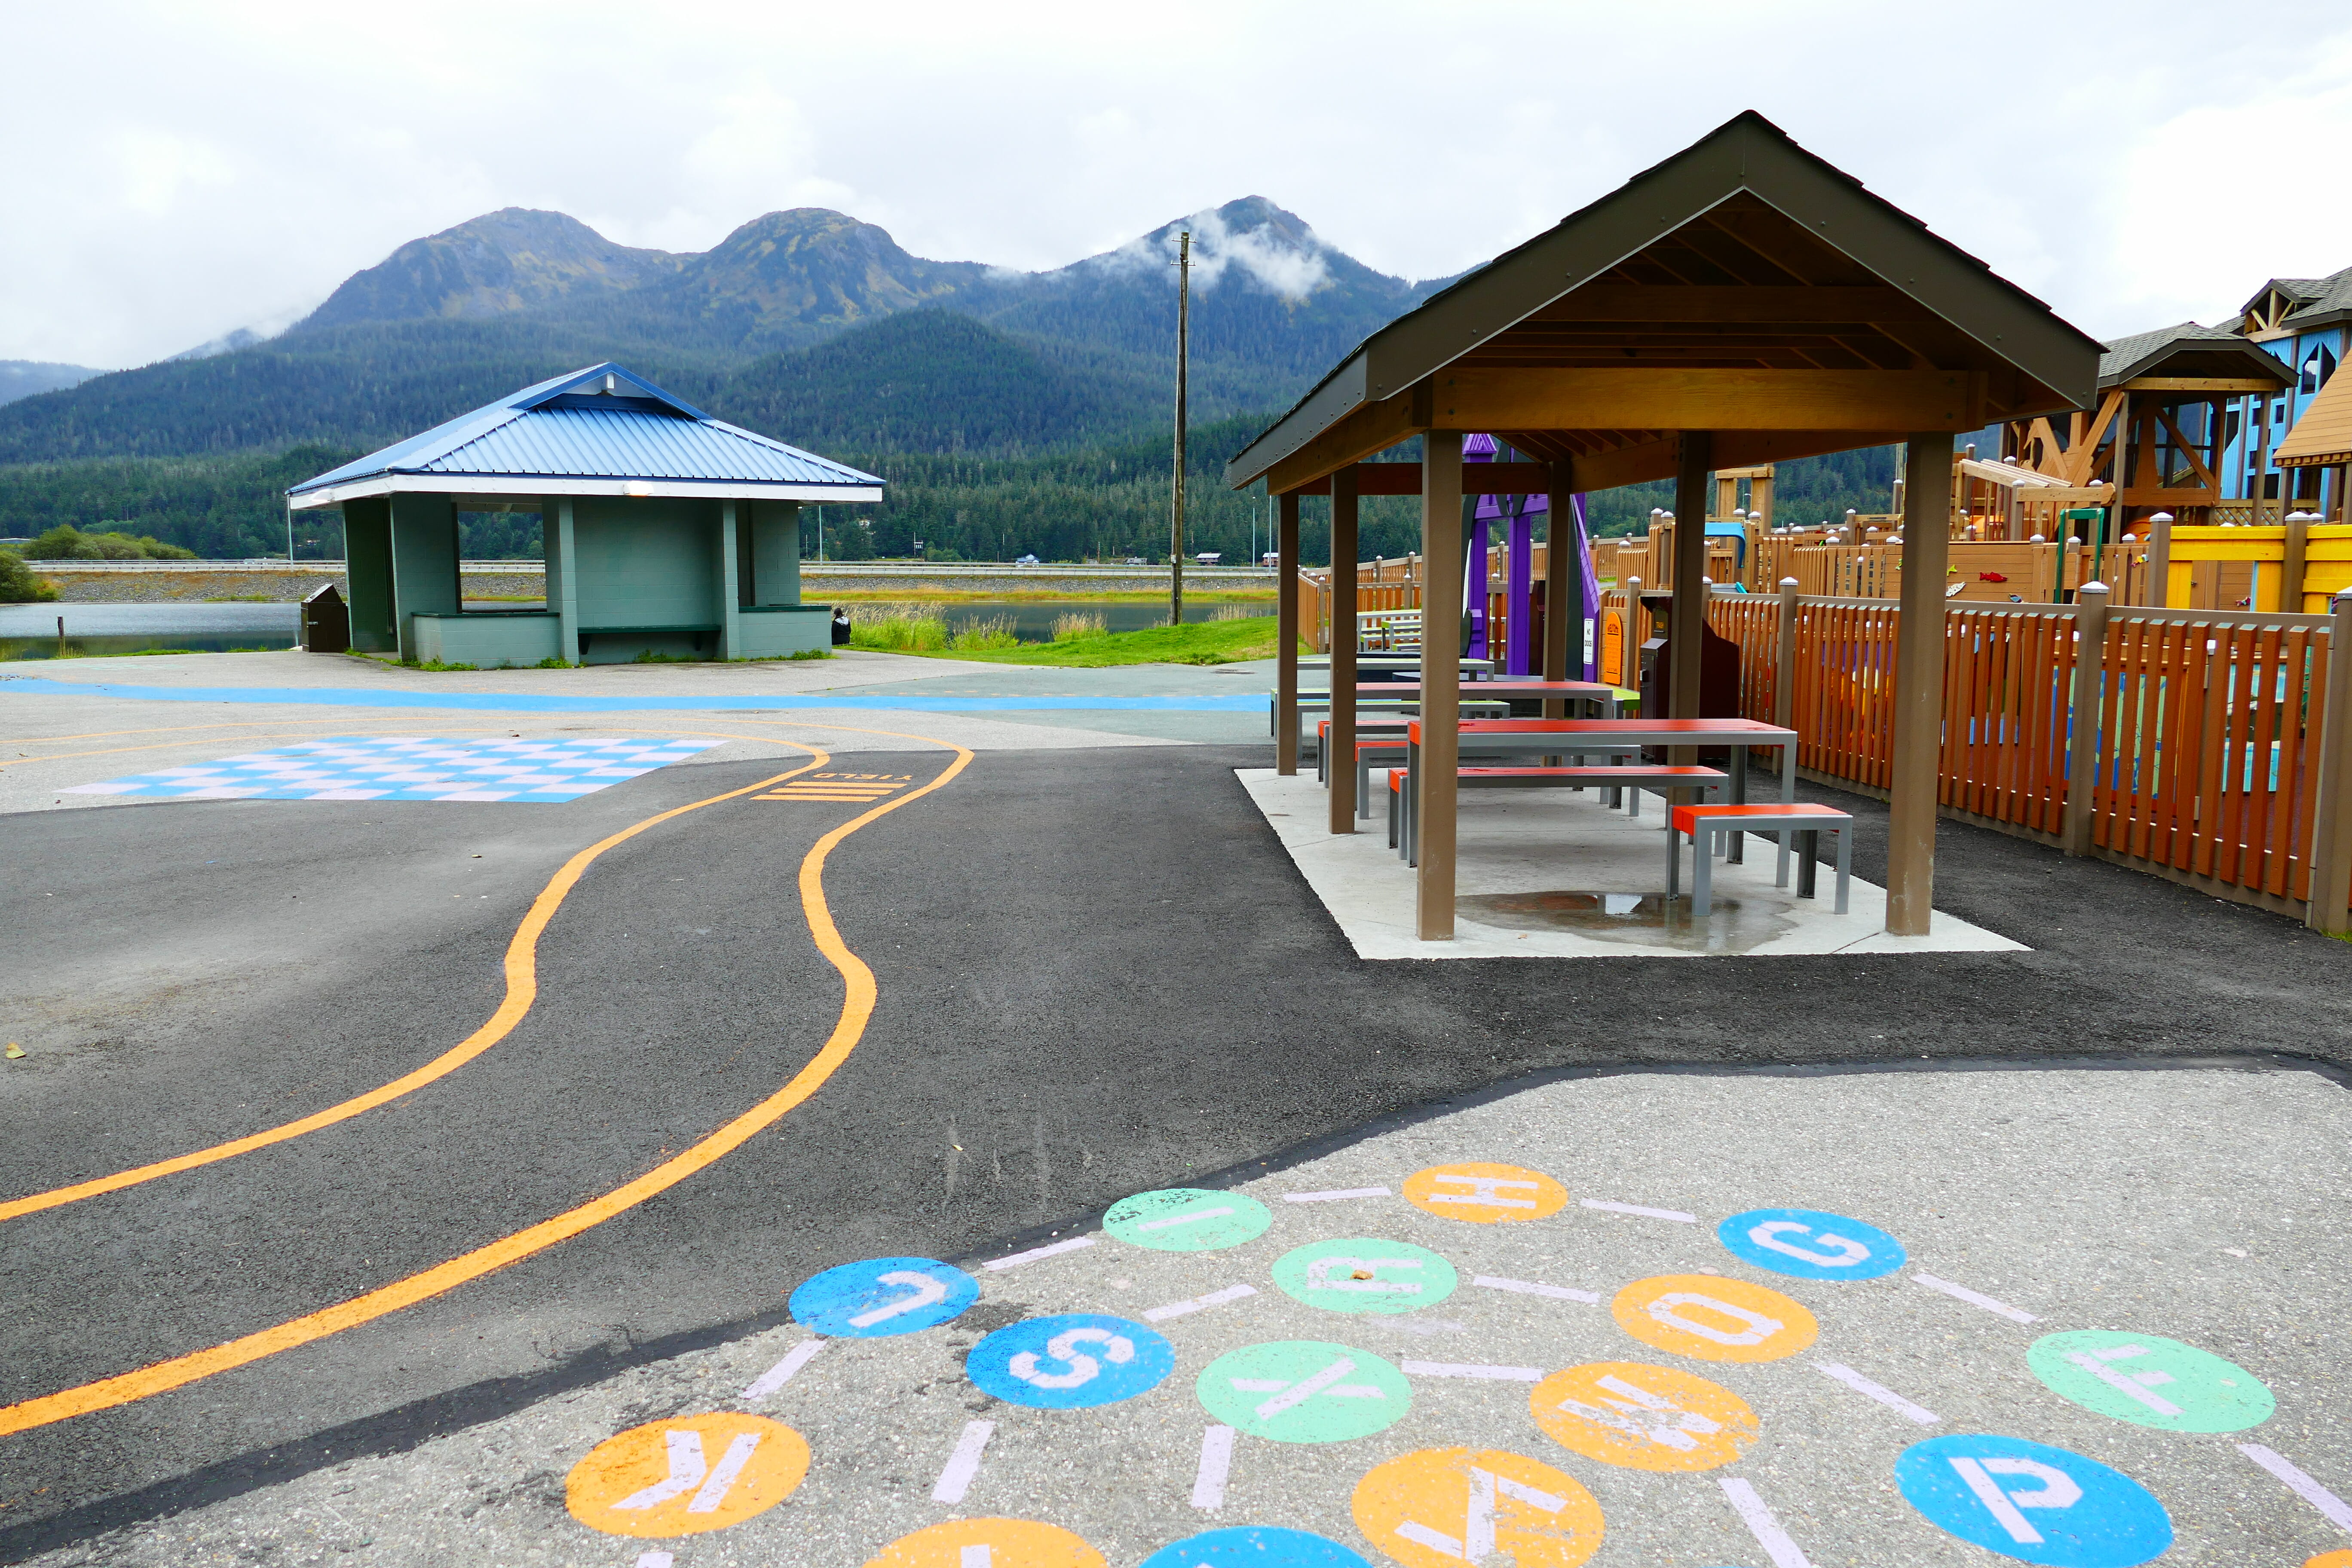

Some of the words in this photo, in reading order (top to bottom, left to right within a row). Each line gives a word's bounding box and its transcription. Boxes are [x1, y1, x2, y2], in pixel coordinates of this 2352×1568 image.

[1429, 1174, 1538, 1209] H
[1749, 1220, 1871, 1267] G
[848, 1271, 947, 1328] J
[1009, 1328, 1135, 1389] S
[1229, 1356, 1385, 1420] X
[2066, 1342, 2185, 1416] F
[610, 1430, 762, 1513] K
[1956, 1457, 2084, 1544] P
